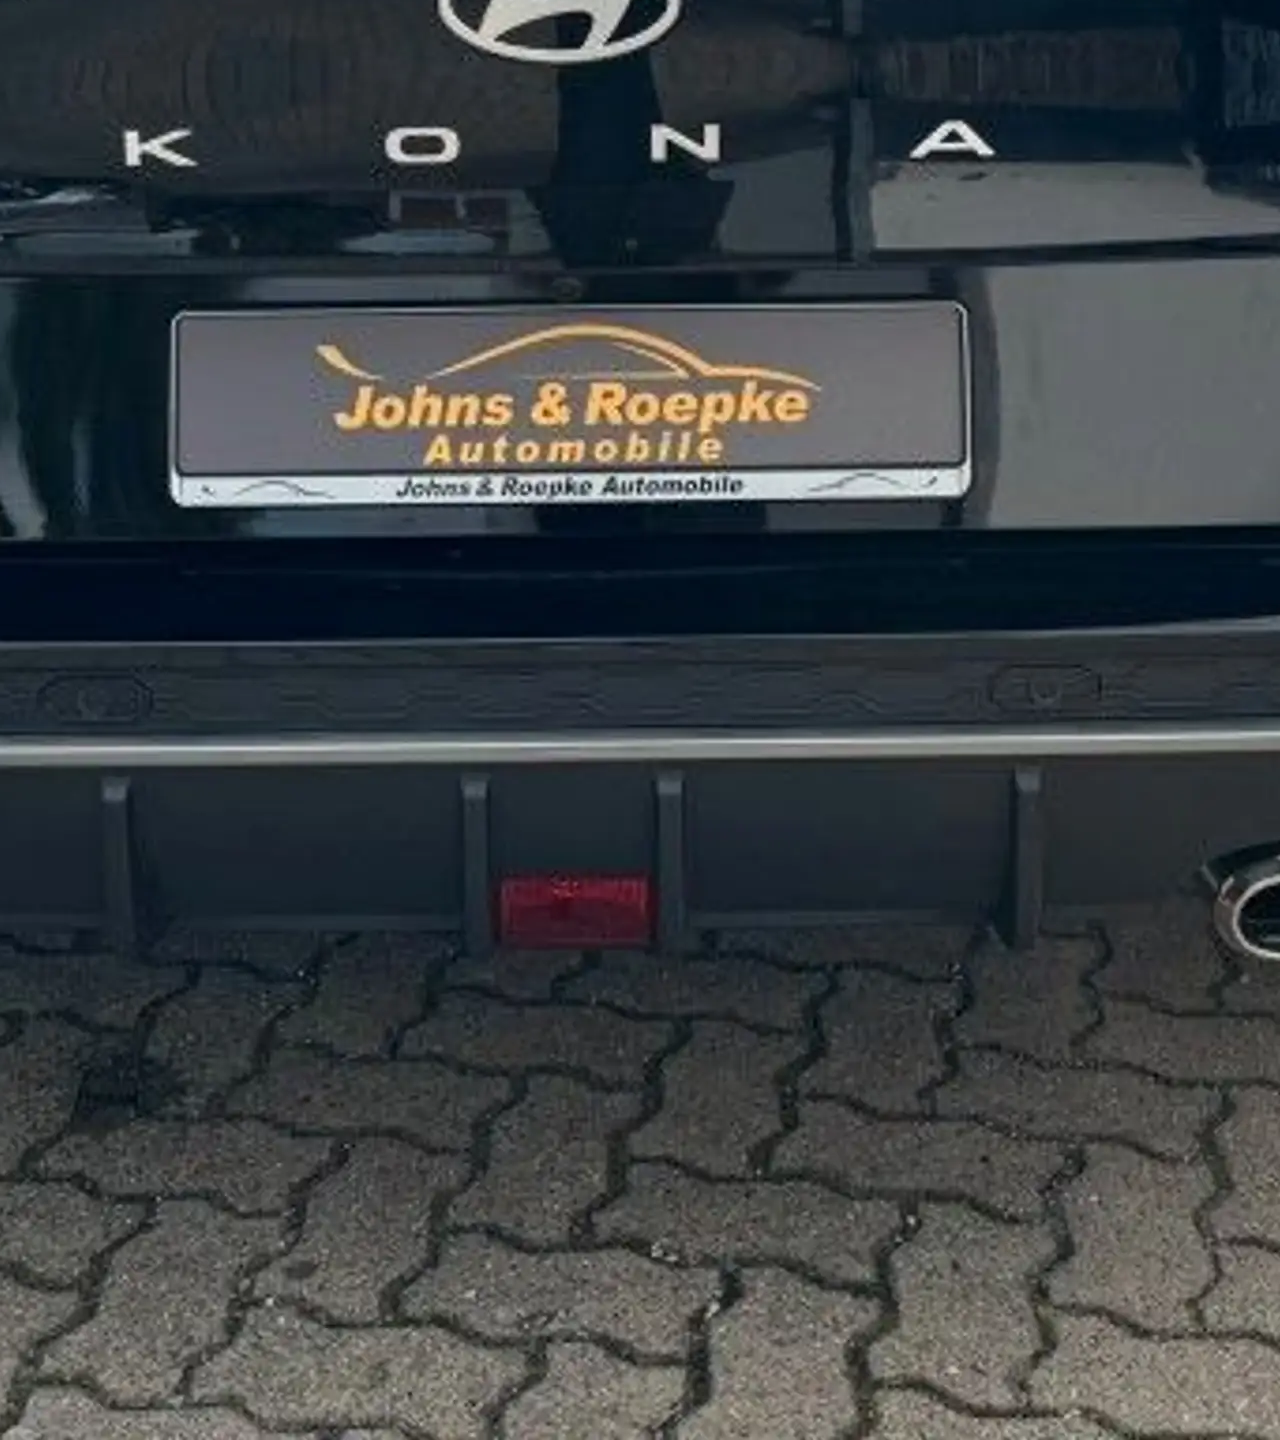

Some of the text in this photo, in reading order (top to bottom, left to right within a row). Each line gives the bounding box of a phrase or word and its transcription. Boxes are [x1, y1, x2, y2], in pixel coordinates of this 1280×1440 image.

[122, 119, 996, 168] KONA
[333, 380, 810, 437] Johns & Roepke
[422, 431, 725, 467] Automobile
[396, 474, 745, 500] Johns & Roepke Automobile
